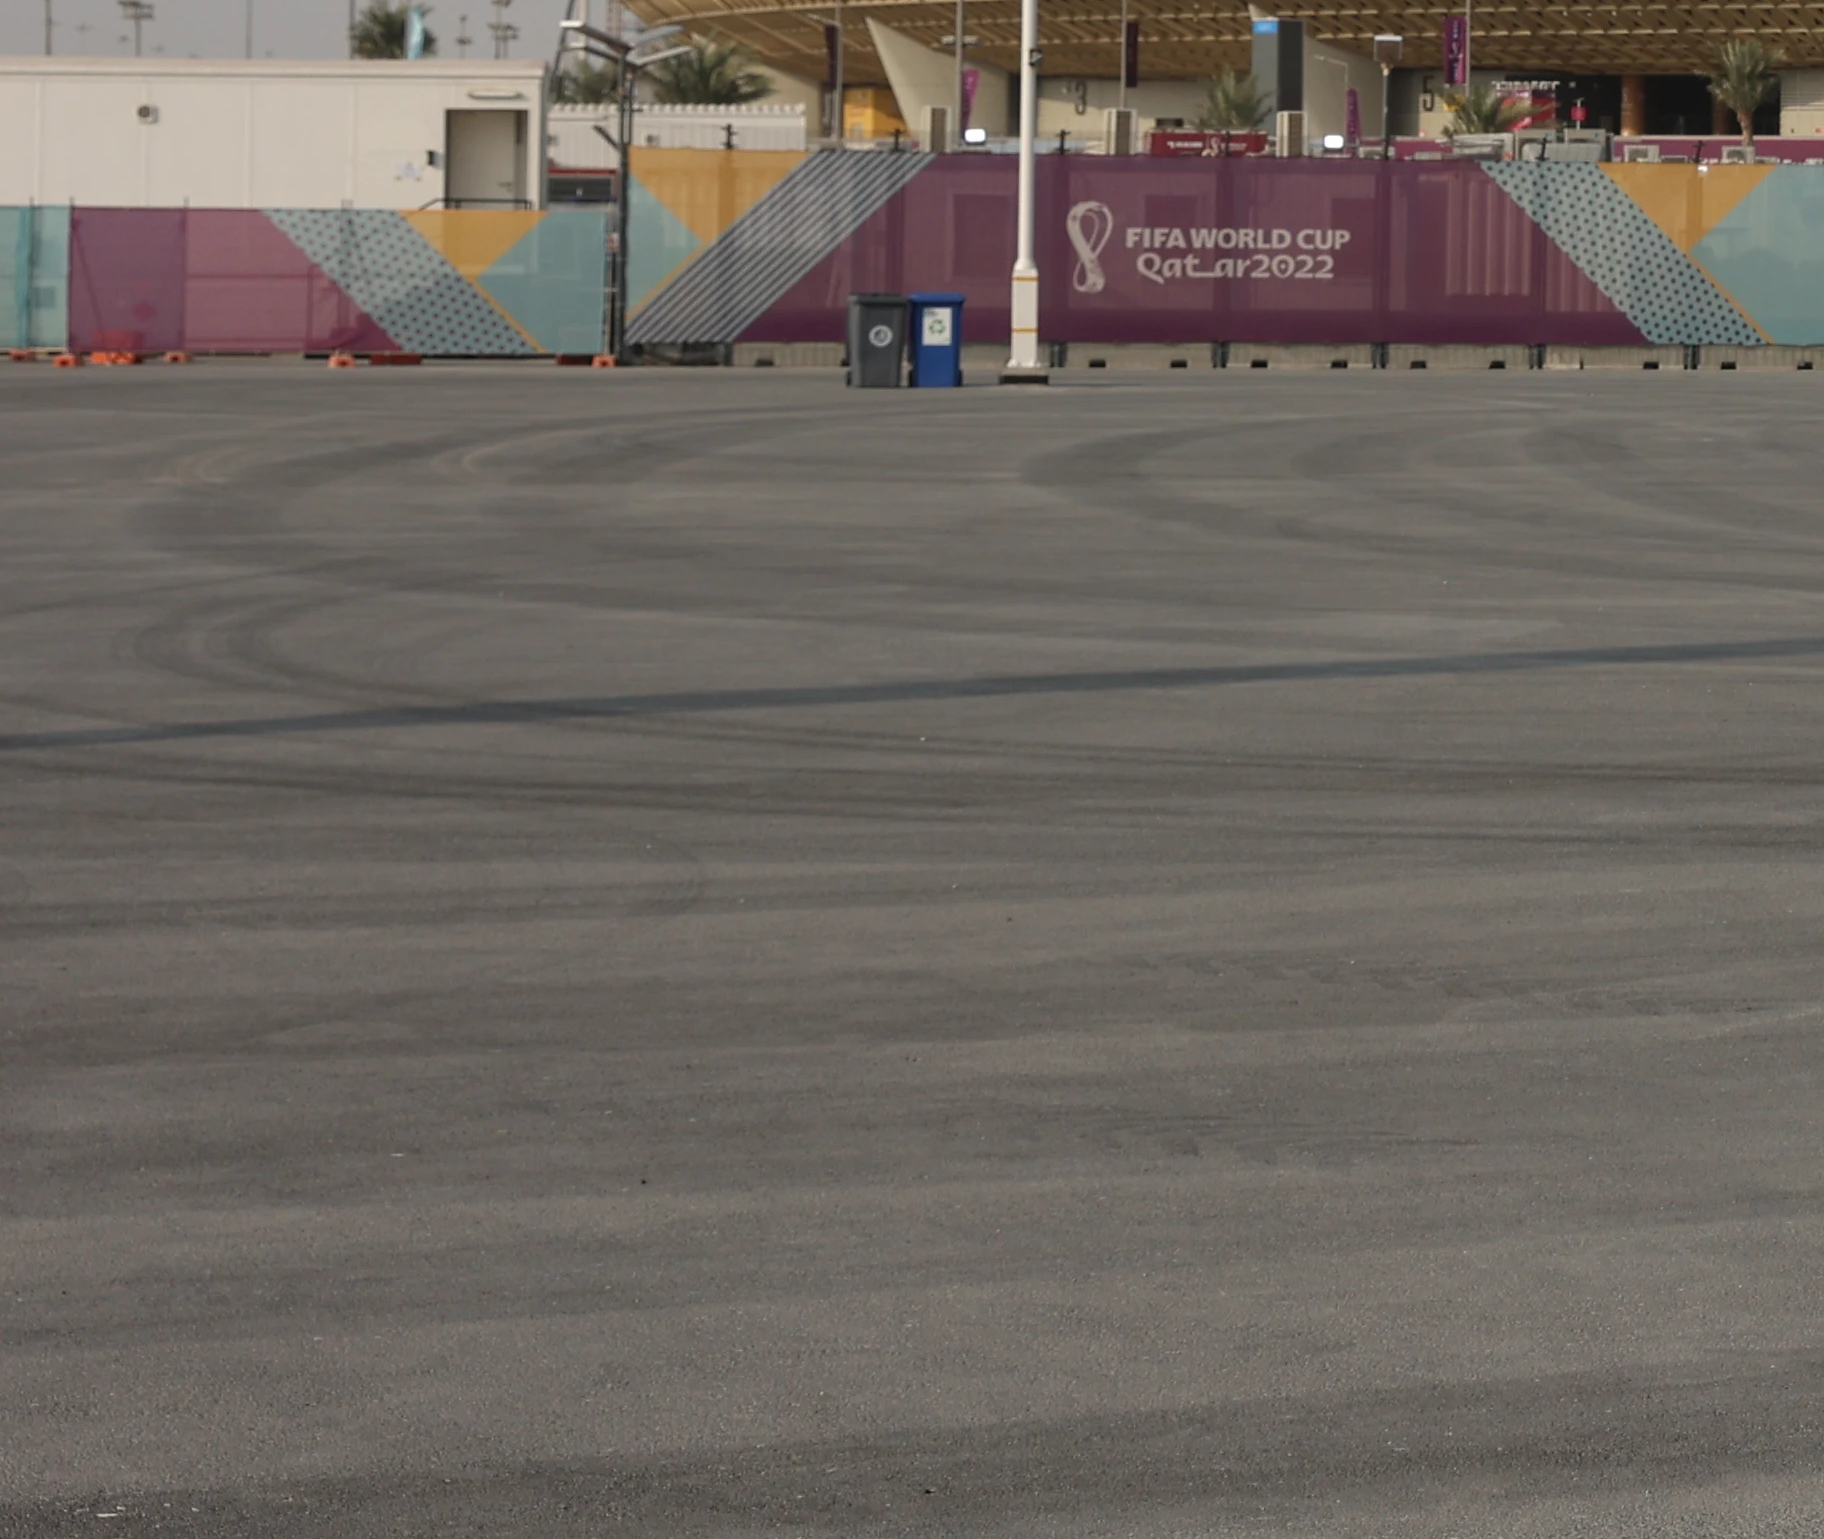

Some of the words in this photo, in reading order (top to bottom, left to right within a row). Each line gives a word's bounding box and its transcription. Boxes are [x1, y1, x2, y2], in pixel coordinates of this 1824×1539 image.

[1125, 227, 1186, 249] FIFA
[1190, 228, 1292, 250] WORLD
[1297, 229, 1351, 251] CUP
